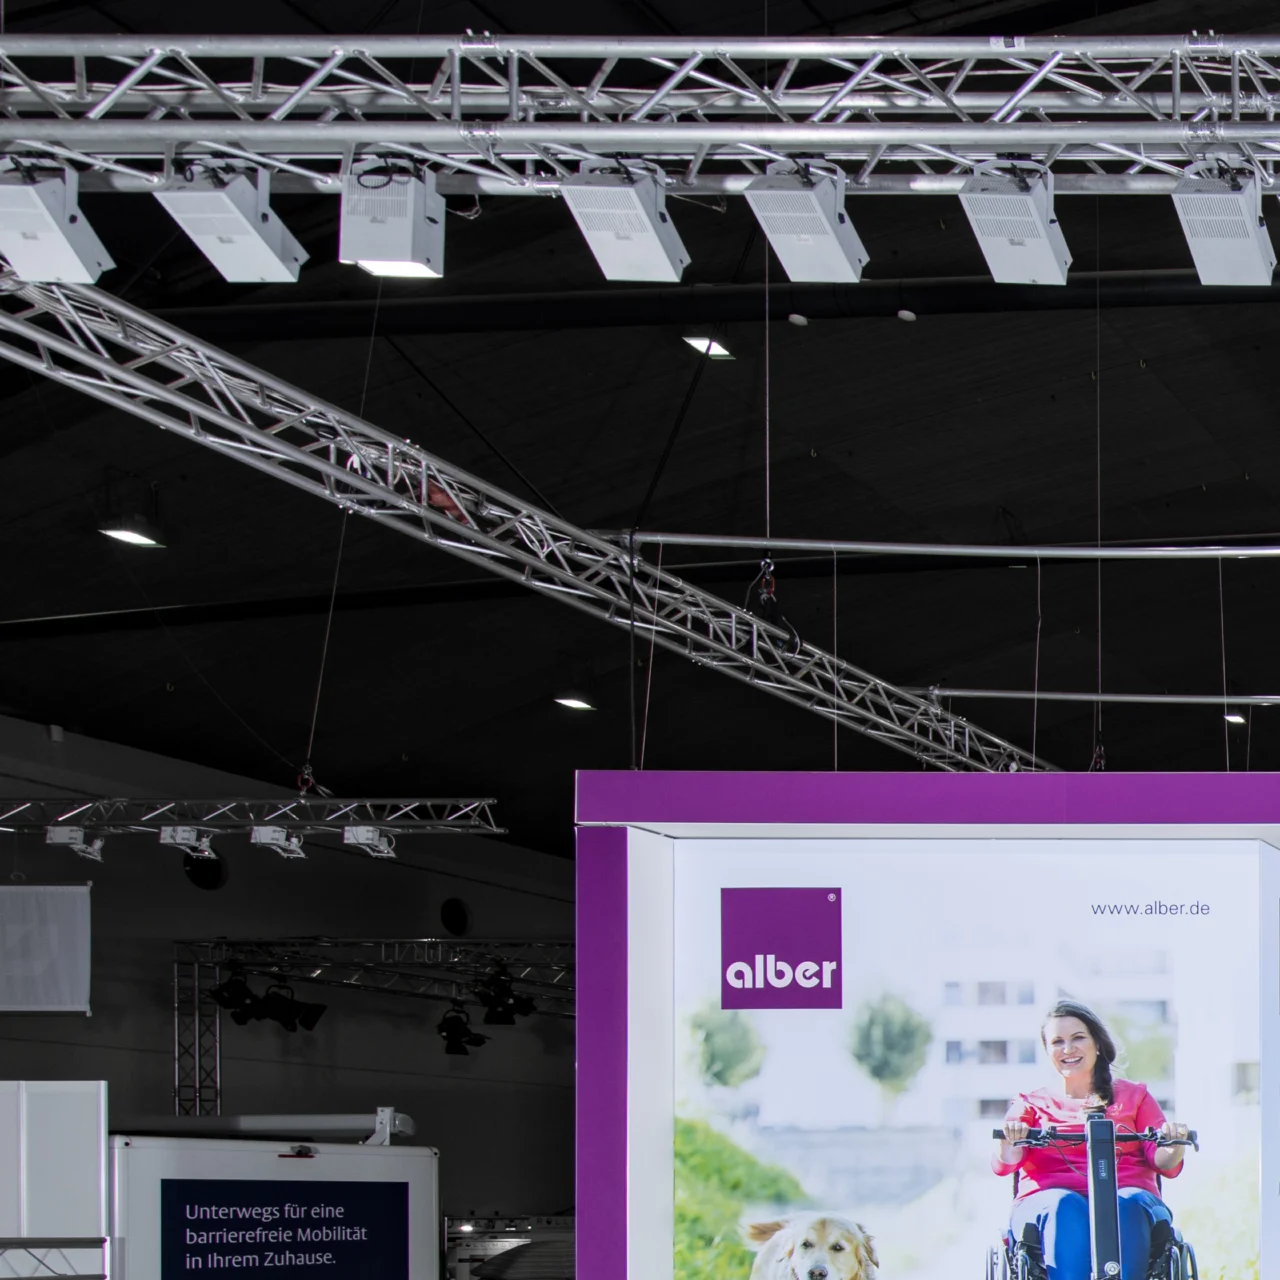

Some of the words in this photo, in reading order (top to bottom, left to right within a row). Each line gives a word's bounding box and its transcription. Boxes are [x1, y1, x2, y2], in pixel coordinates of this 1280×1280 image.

[1090, 901, 1210, 916] www.alber.de
[725, 954, 837, 989] alber
[185, 1203, 280, 1223] Unterwegs
[284, 1202, 307, 1219] für
[310, 1203, 345, 1219] eine
[185, 1226, 293, 1245] barrierefreie
[296, 1225, 368, 1242] Mobilität
[185, 1253, 203, 1270] in
[207, 1252, 260, 1269] Ihrem
[263, 1250, 337, 1267] Zuhause.
